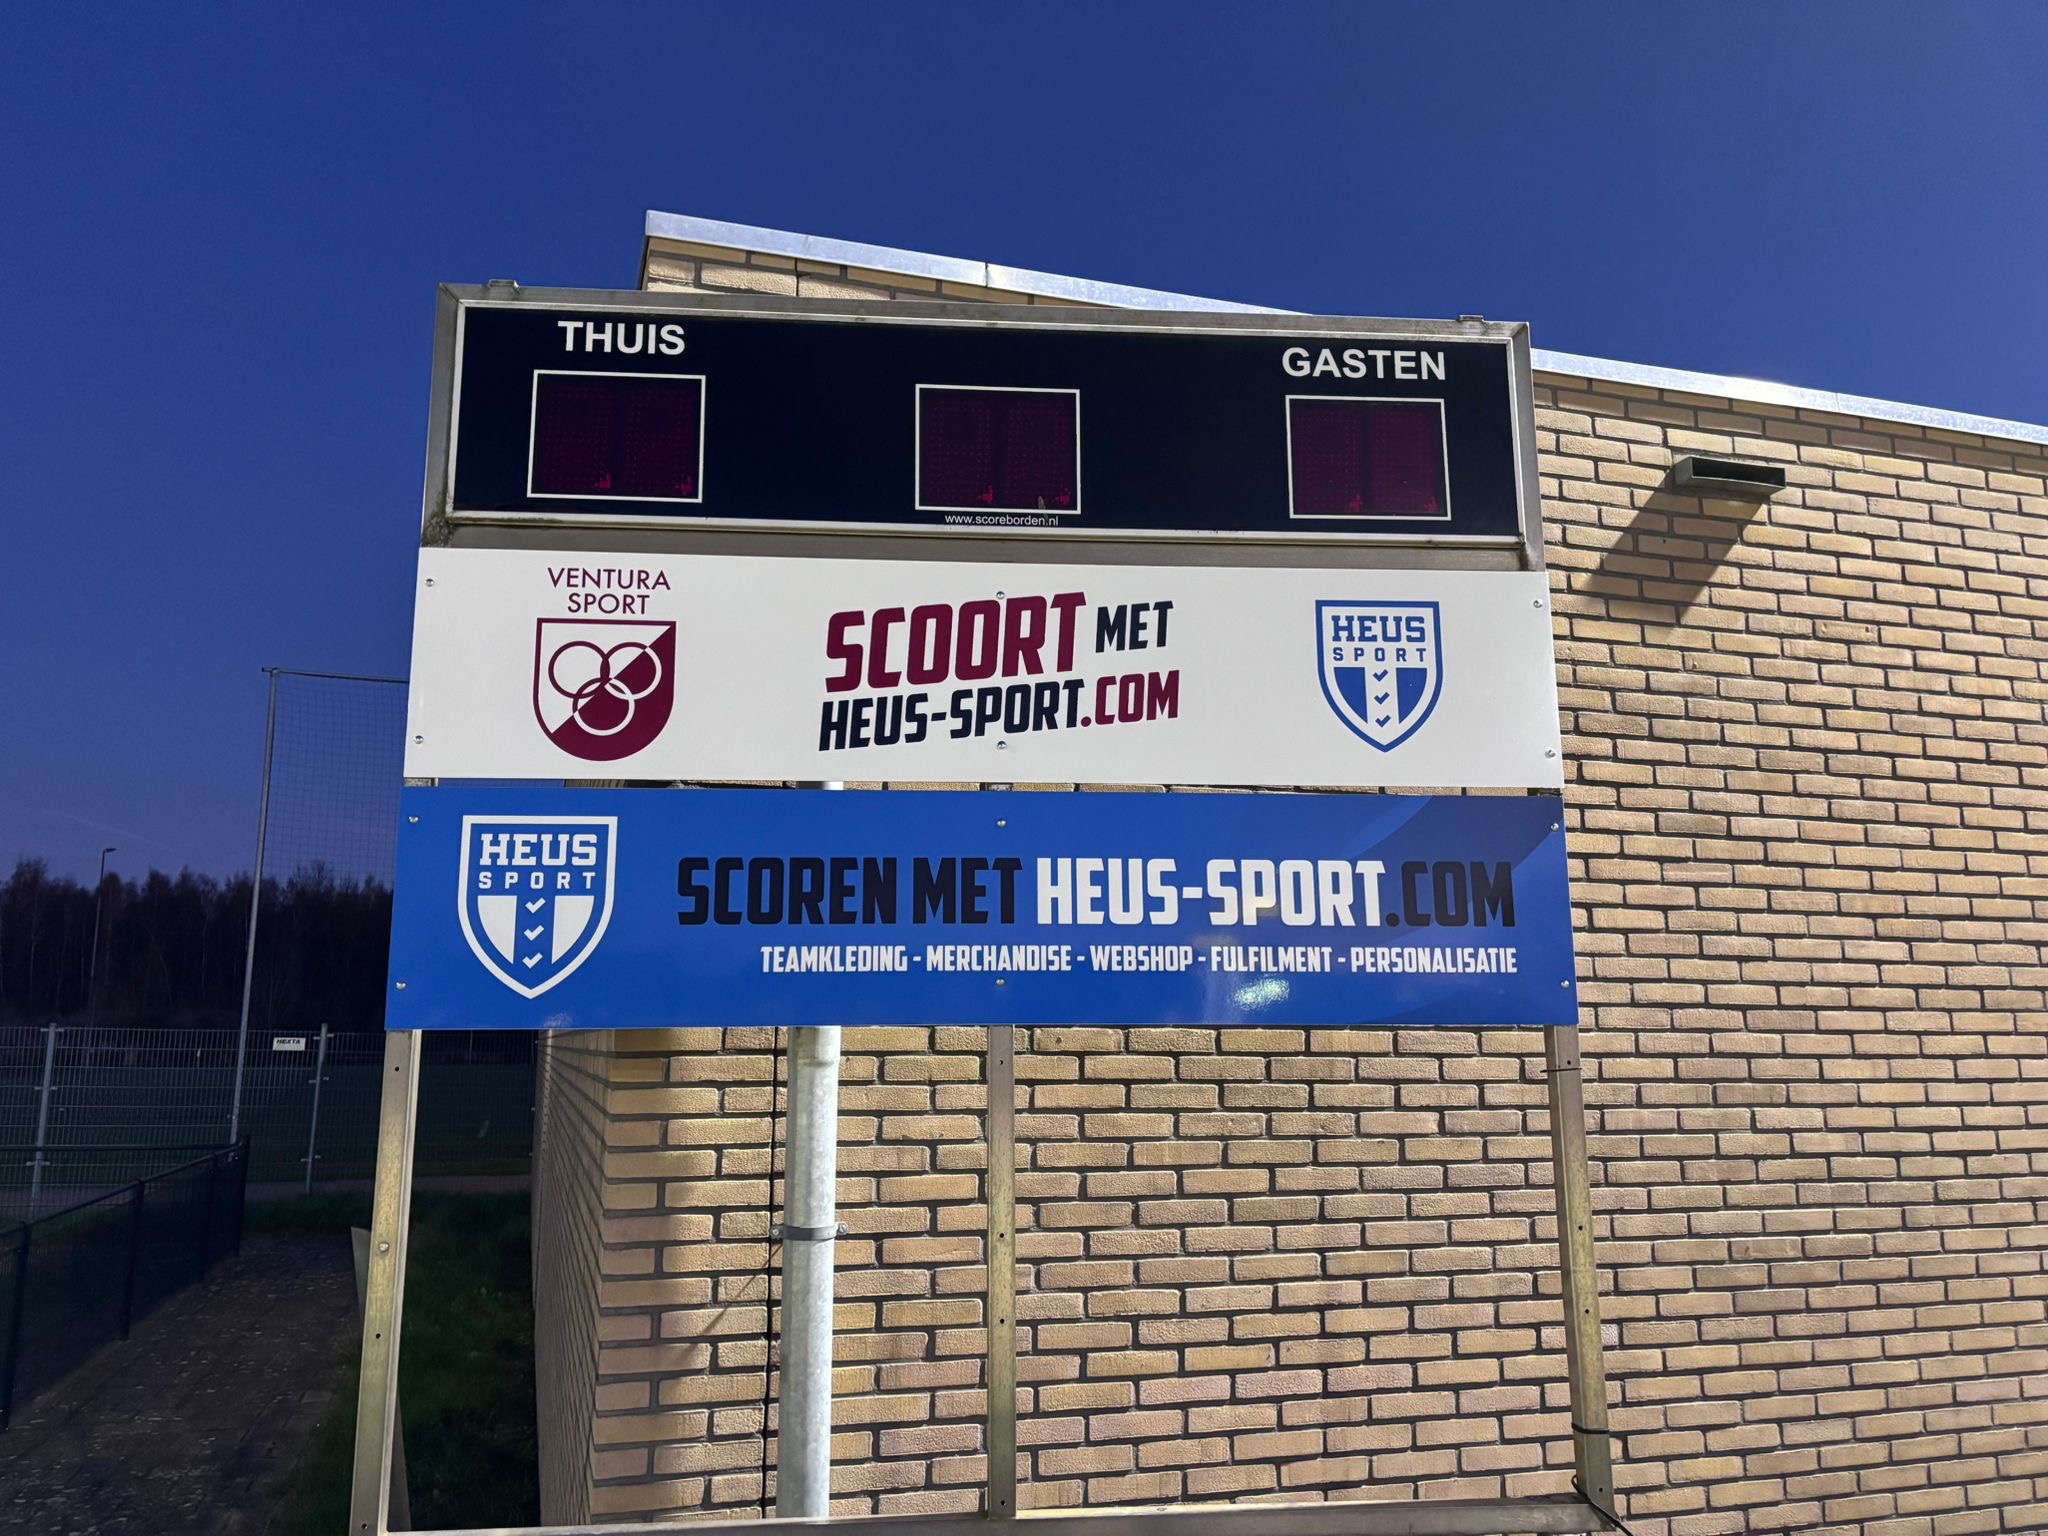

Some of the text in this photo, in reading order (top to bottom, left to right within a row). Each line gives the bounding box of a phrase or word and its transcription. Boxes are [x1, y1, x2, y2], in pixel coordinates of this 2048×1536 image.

[558, 320, 686, 356] THUIS
[1282, 346, 1446, 381] GASTEN
[944, 514, 1059, 526] www.scoreborden.nl
[547, 567, 671, 591] VENTURA
[567, 593, 650, 615] SPORT
[825, 591, 1174, 693] SCOORT MET
[1331, 615, 1426, 643] HEUS
[1333, 647, 1427, 662] SPORT
[818, 670, 1180, 751] HEUS-SPORT.COM
[479, 833, 598, 866] HEUS
[478, 871, 596, 889] SPORT
[677, 857, 1516, 927] SCOREN MET HEUS-SPORT.COM
[761, 945, 908, 973] TEAMKLEDING
[926, 945, 1072, 972] MERCHANDISE
[1090, 945, 1194, 972] WEBSHOP
[1210, 946, 1333, 972] FULFILMENT
[1350, 946, 1518, 973] PERSONALISATIE
